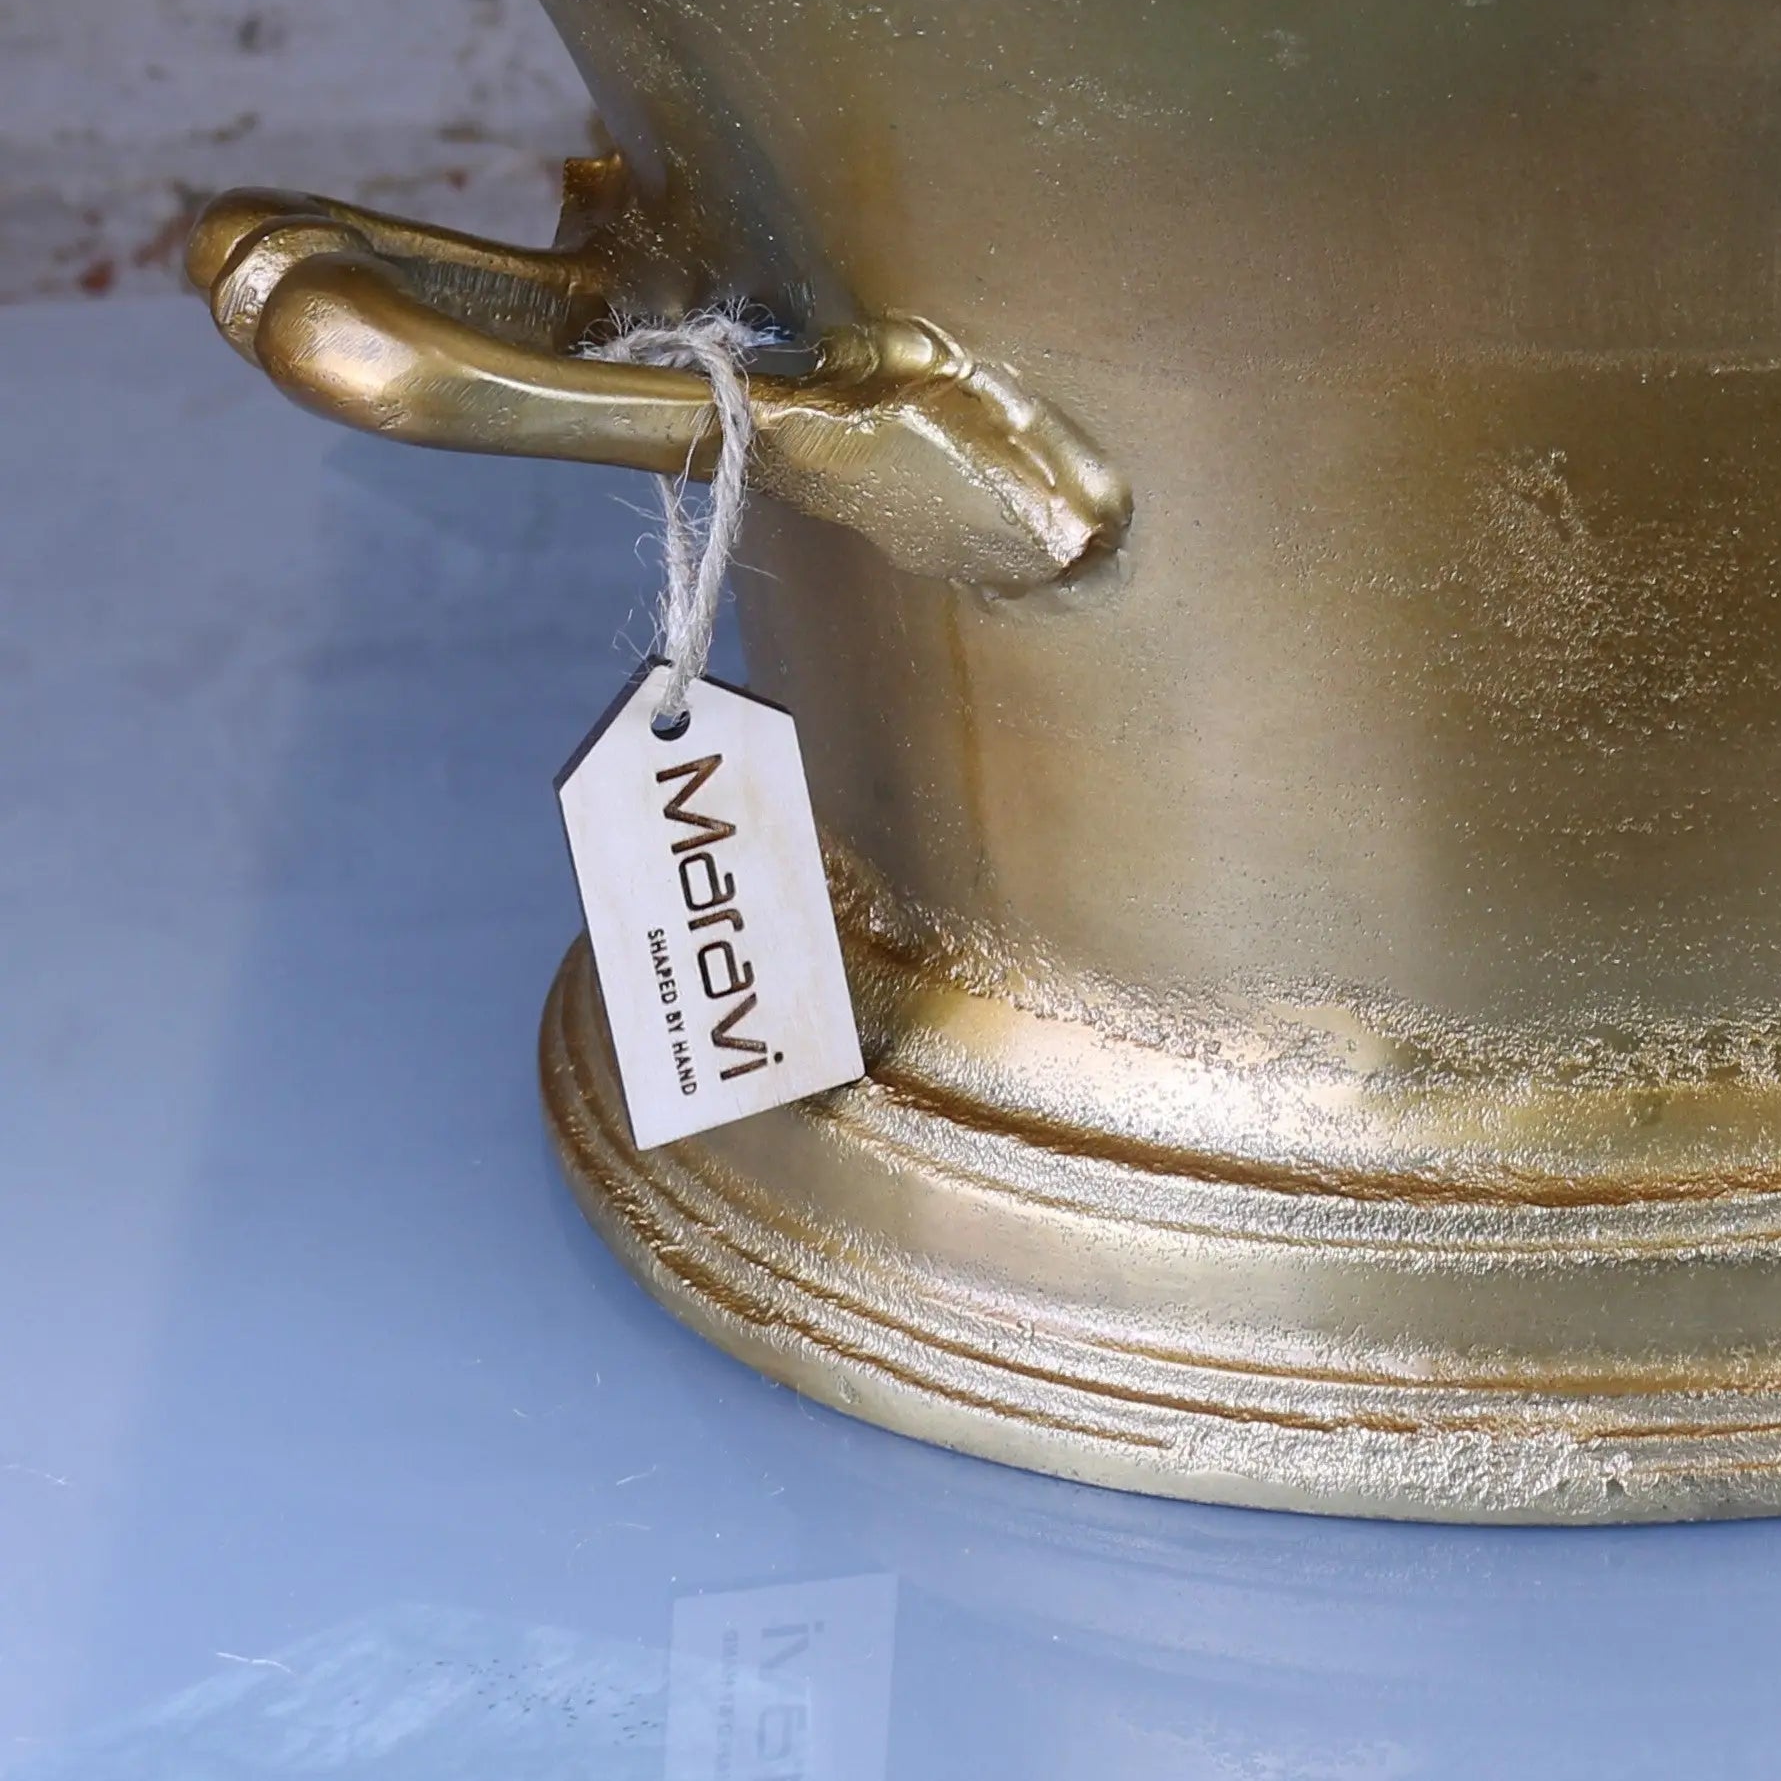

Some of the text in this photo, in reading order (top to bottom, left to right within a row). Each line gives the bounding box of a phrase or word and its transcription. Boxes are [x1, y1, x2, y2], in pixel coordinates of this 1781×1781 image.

[647, 928, 698, 1096] SHAPED BY HAND
[656, 754, 783, 1080] Maravi
